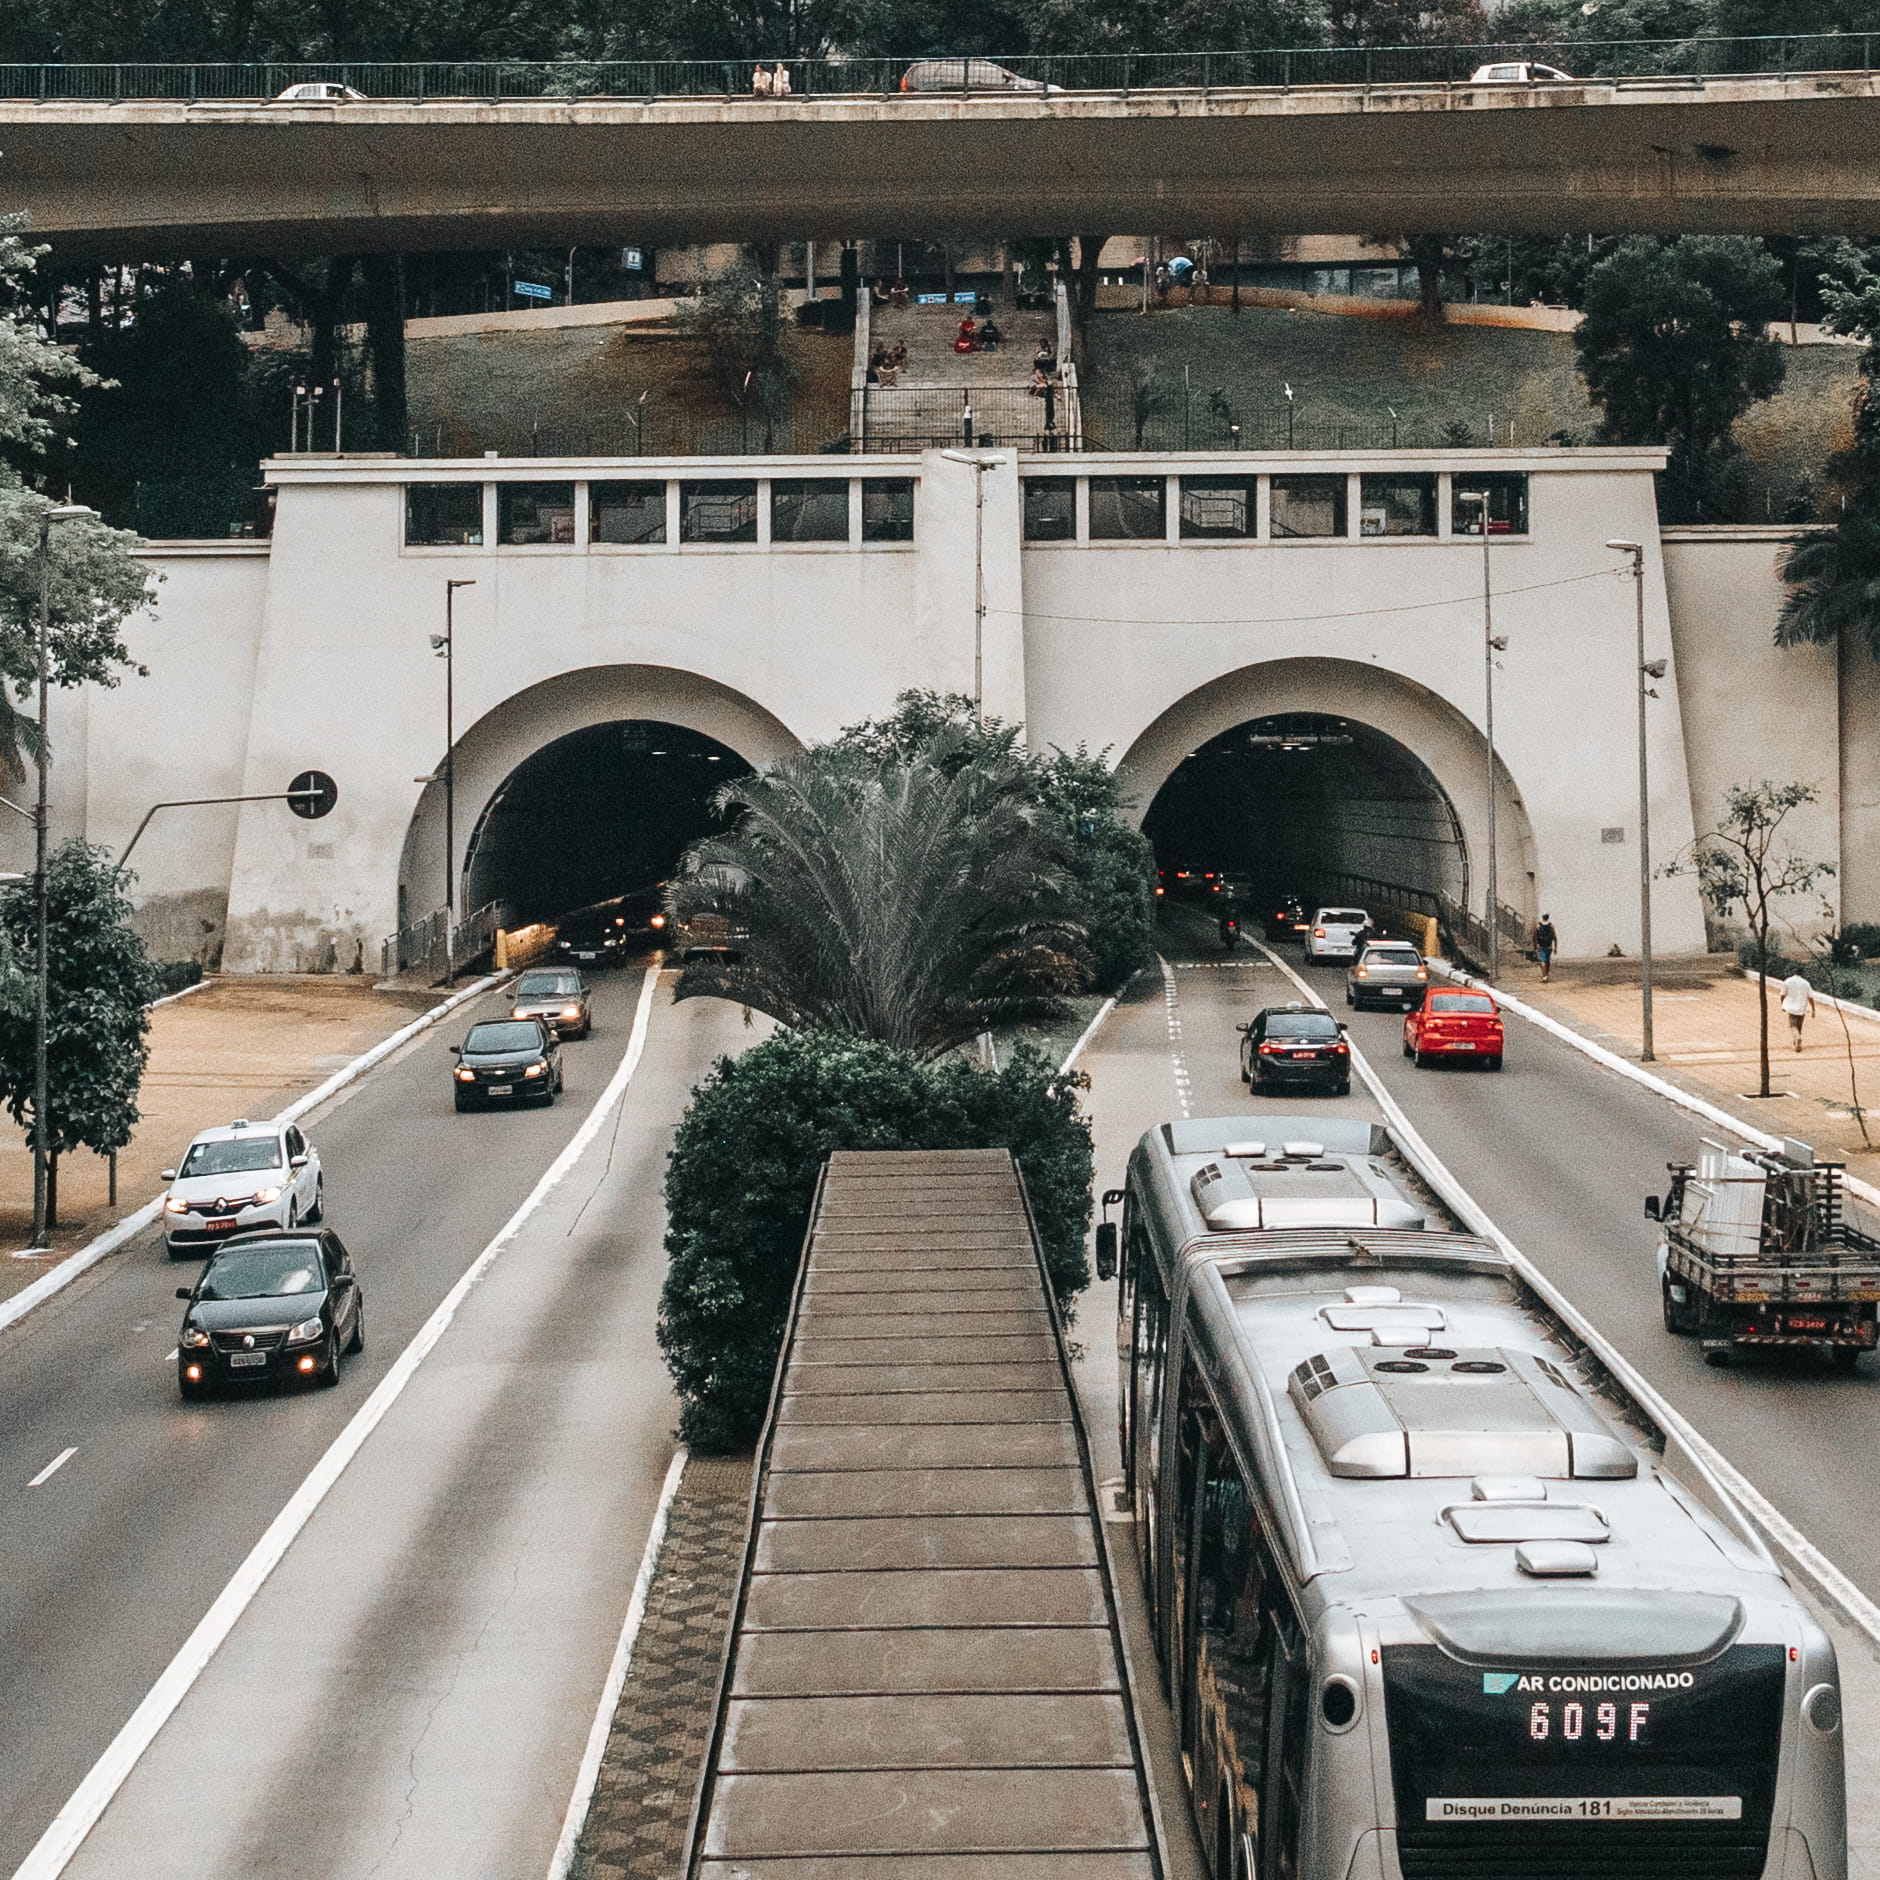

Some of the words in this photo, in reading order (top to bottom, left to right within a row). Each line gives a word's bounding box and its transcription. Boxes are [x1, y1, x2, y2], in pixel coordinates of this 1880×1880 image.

[1517, 1676, 1545, 1691] AR
[1548, 1672, 1694, 1692] CONDICIONADO
[1530, 1702, 1650, 1741] 609F
[1443, 1803, 1496, 1817] Disque
[1500, 1802, 1572, 1815] Denúncia
[1578, 1801, 1611, 1816] 181
